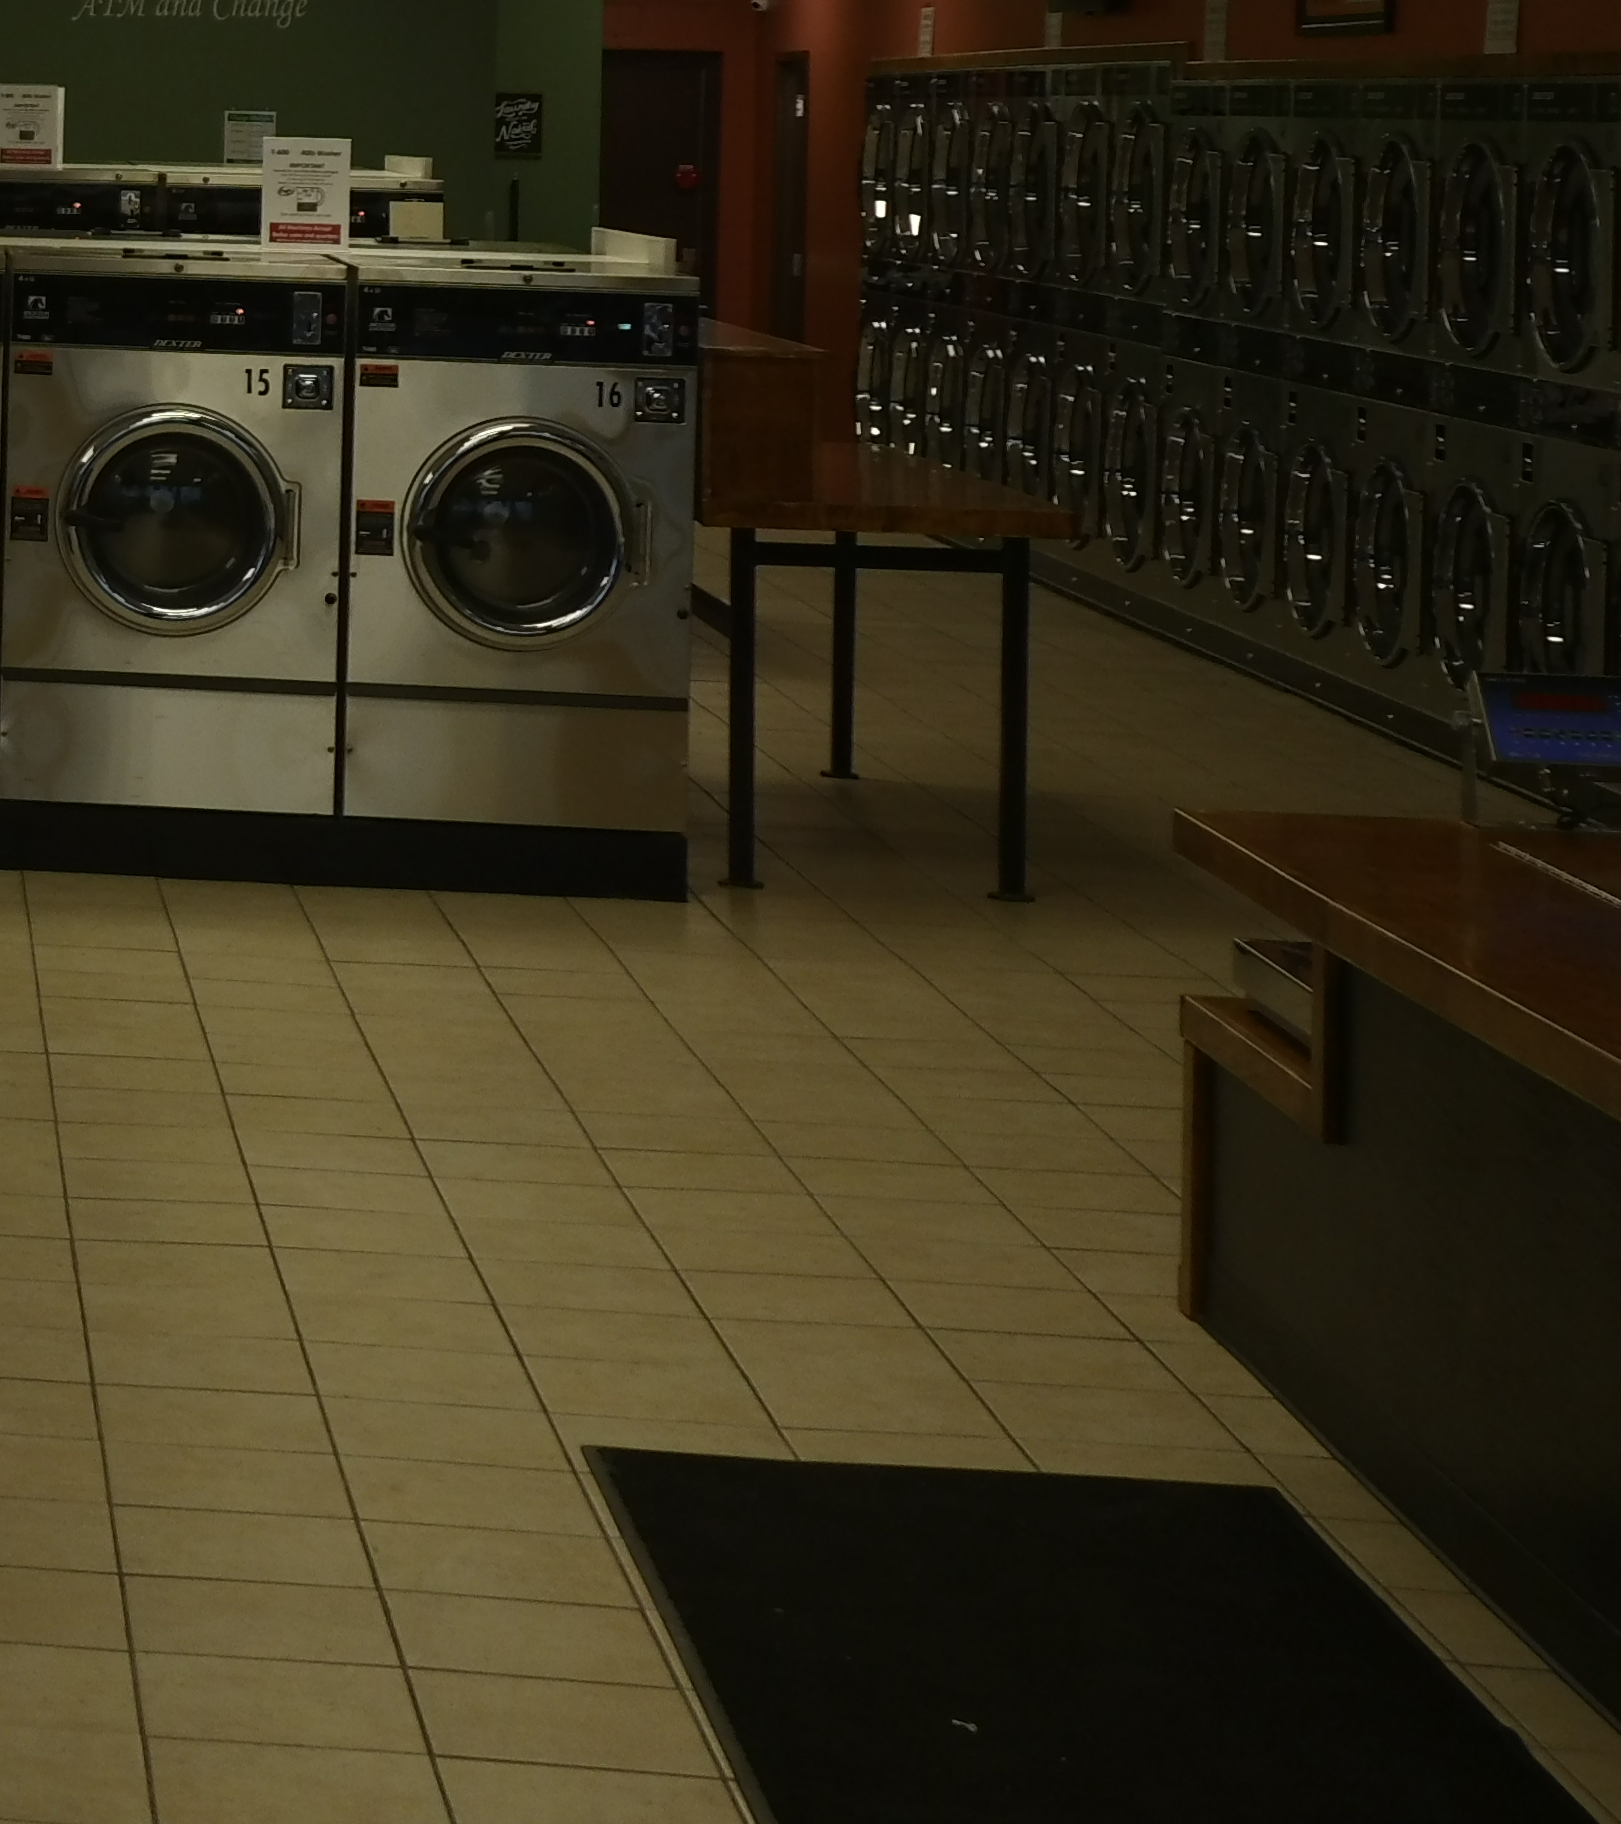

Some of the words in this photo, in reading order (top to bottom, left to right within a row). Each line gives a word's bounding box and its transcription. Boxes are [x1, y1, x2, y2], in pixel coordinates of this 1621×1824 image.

[153, 338, 203, 349] DEXTER
[500, 350, 553, 361] DEXTER
[244, 368, 271, 397] 15
[596, 381, 622, 408] 16
